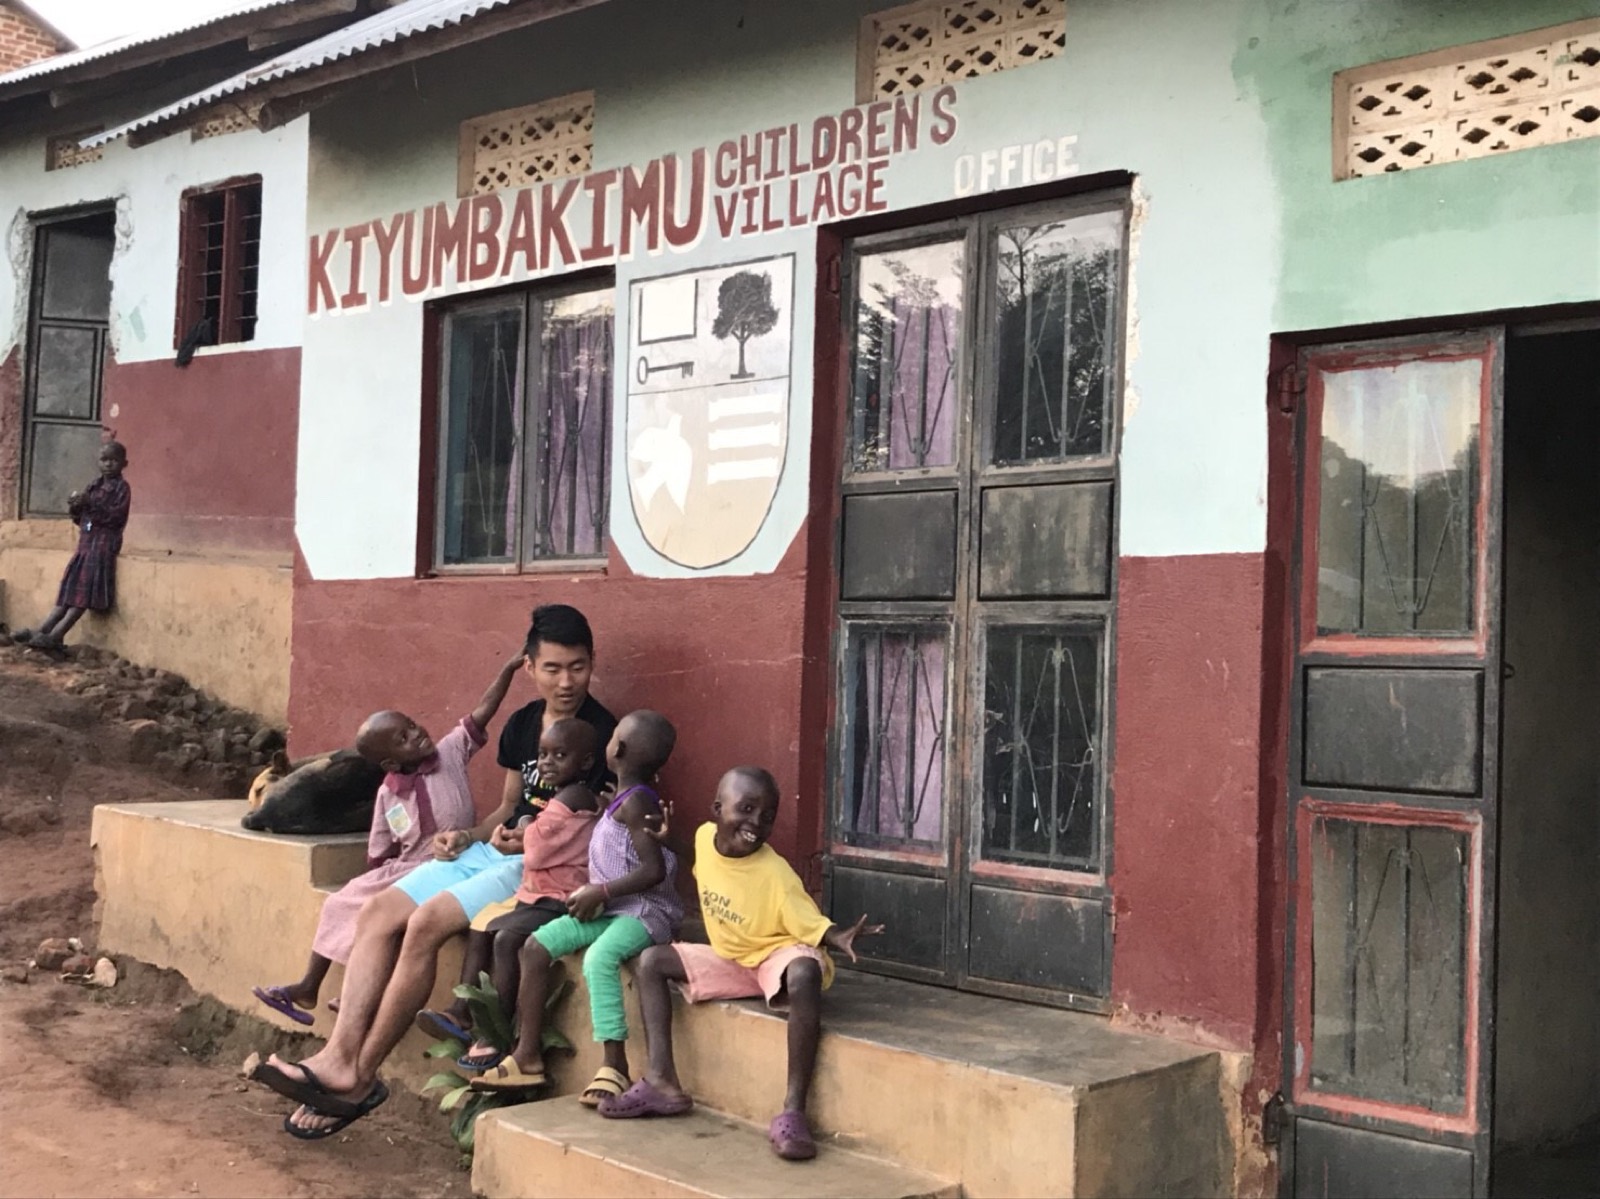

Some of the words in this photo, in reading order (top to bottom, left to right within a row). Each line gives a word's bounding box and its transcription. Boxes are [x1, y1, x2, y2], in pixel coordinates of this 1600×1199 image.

[714, 160, 890, 238] VILLAGE
[954, 135, 1080, 198] OFFICE
[308, 148, 709, 317] KIYUMBAKIMU
